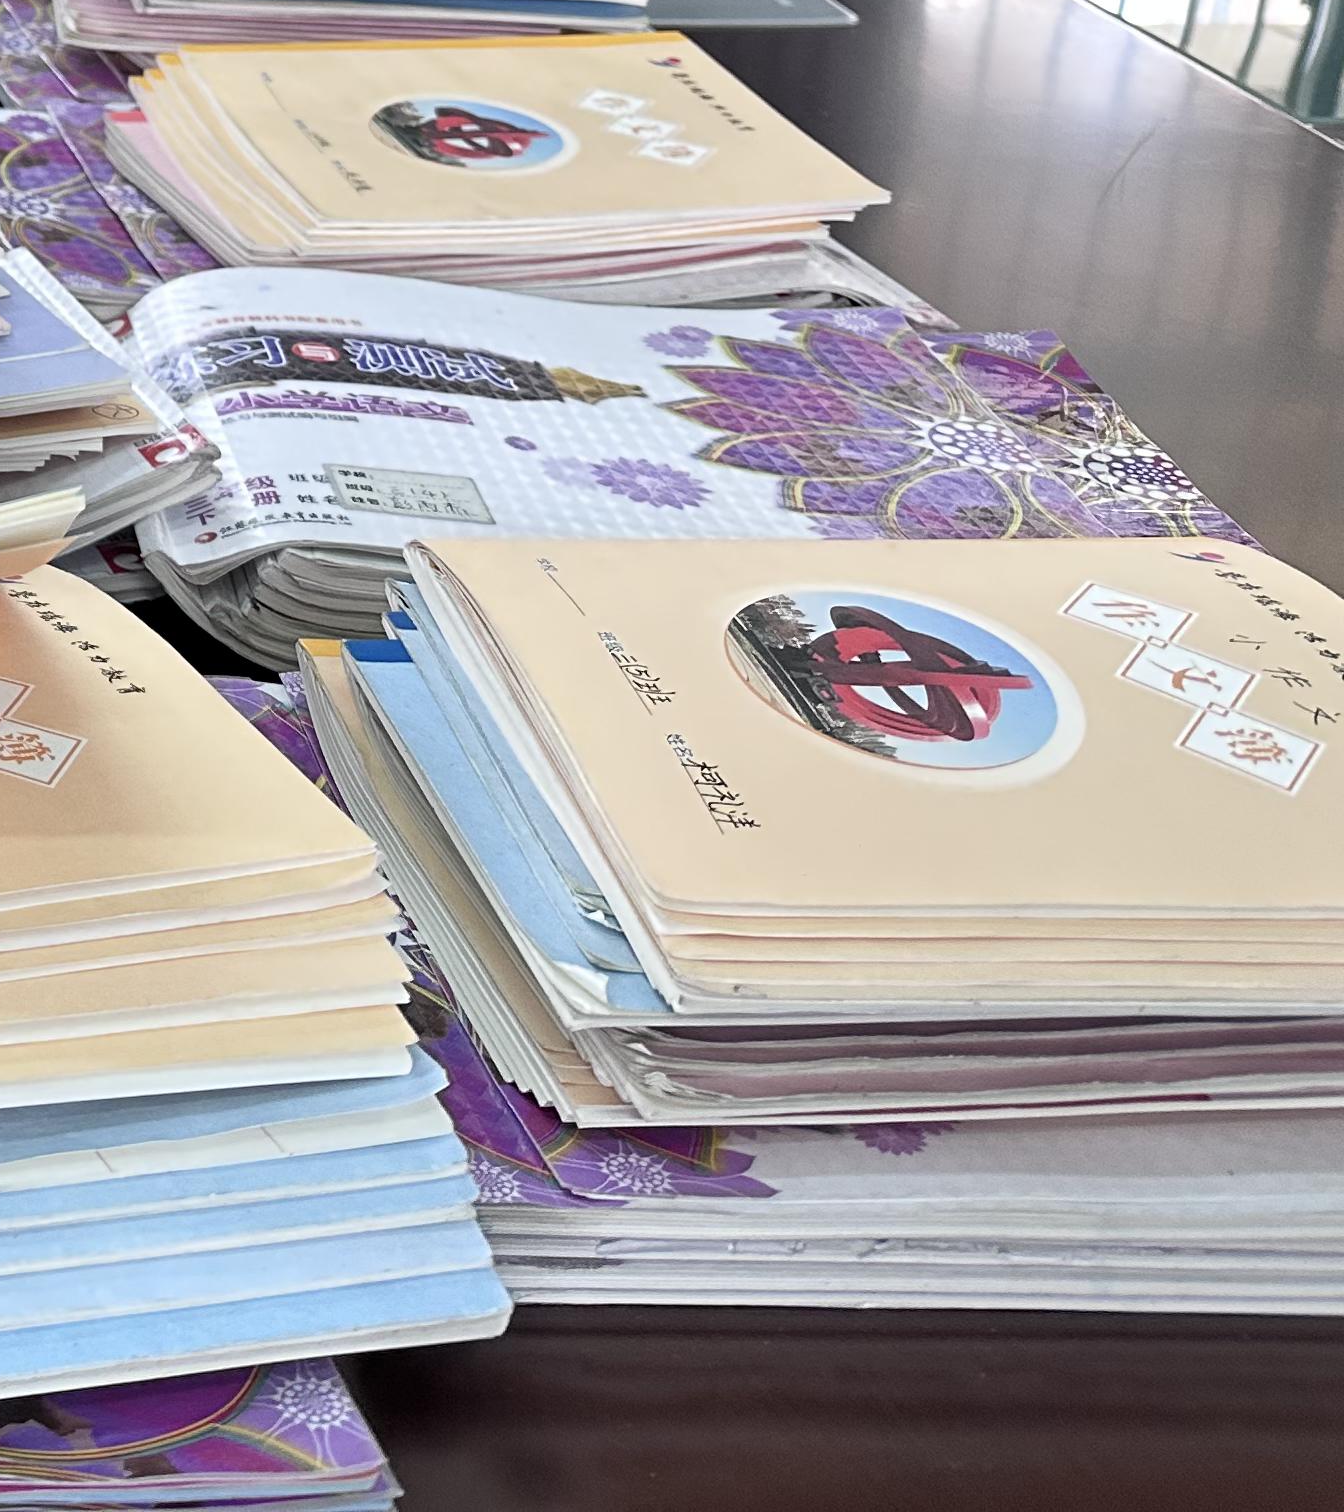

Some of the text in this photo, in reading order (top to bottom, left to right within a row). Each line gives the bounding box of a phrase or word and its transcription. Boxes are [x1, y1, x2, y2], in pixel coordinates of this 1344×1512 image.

[215, 390, 474, 426] 小学语文
[71, 640, 146, 694] 活力教育
[1093, 602, 1293, 765] 作文簿
[1229, 634, 1341, 726] 小作文
